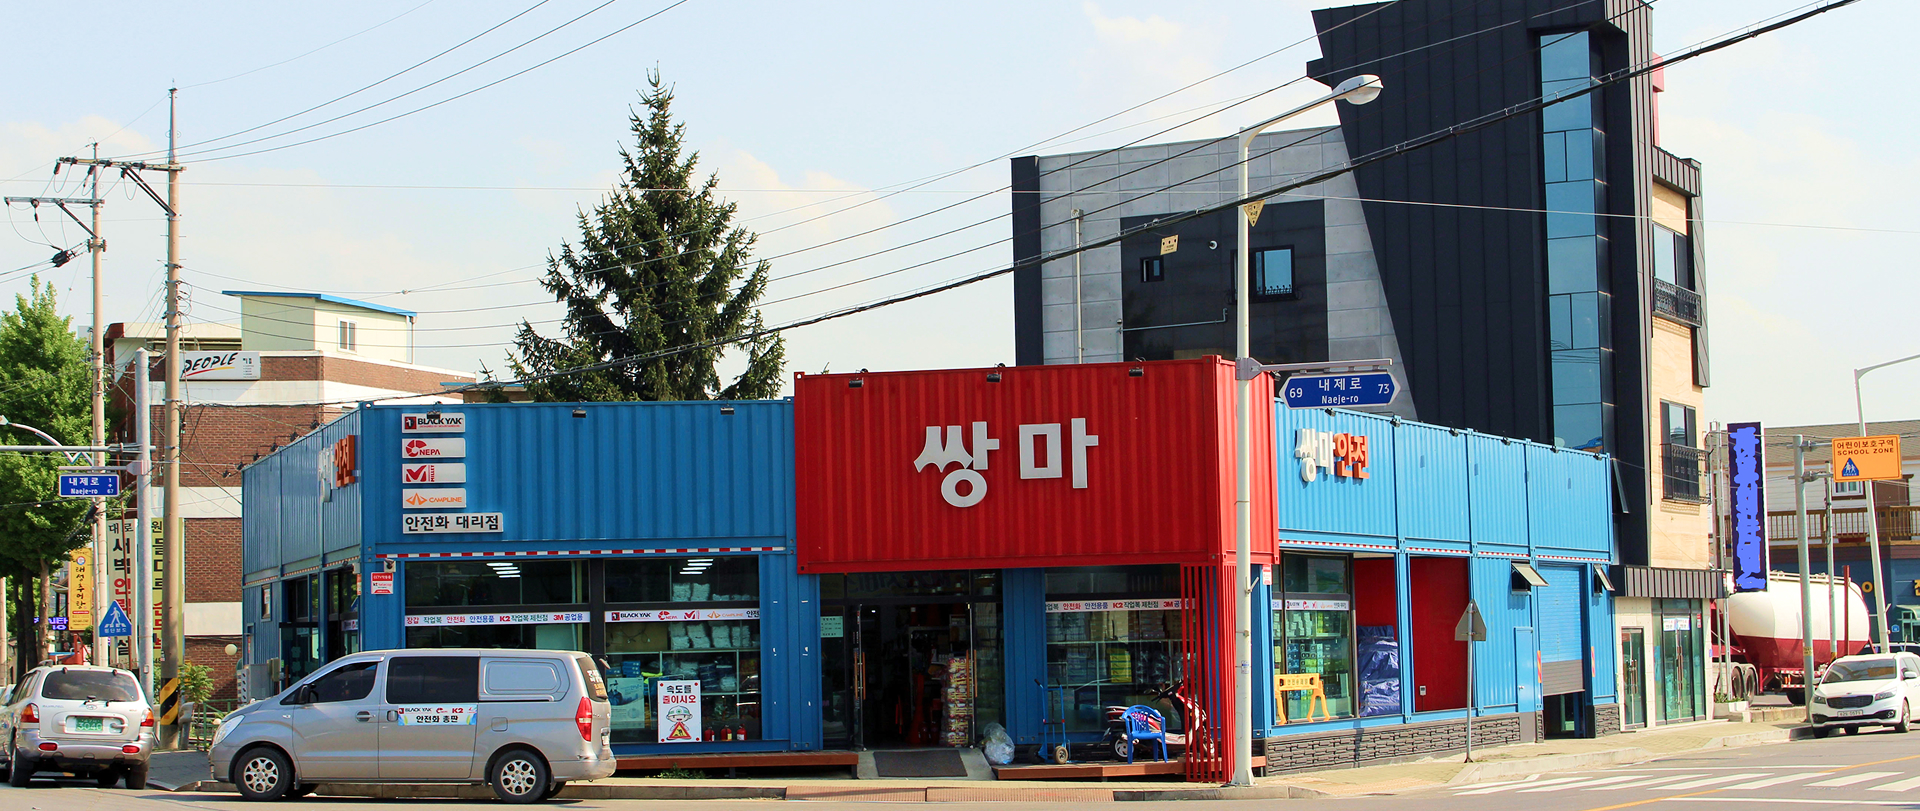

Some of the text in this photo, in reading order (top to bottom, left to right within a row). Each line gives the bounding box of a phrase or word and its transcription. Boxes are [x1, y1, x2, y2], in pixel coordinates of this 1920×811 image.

[180, 352, 238, 378] PEOPLE
[1318, 377, 1362, 391] 내제로
[1378, 383, 1390, 394] 73
[1289, 388, 1303, 398] 69
[1321, 395, 1359, 405] Naeje-ro
[1836, 439, 1894, 449] 어린이보호구역
[419, 448, 441, 456] NEPA
[913, 418, 1099, 507] 쌍마
[69, 477, 99, 486] 내제로
[70, 488, 99, 496] Naeje-ro
[405, 515, 499, 532] 안전화 대리점
[1063, 602, 1081, 610] 안전화
[1084, 601, 1108, 610] 안전용품
[1112, 601, 1124, 609] K2
[406, 616, 420, 624] 장갑
[446, 615, 466, 624] 안전화
[469, 614, 495, 623] 안전용품
[666, 684, 692, 694] 속도를
[416, 715, 440, 723] 안전화
